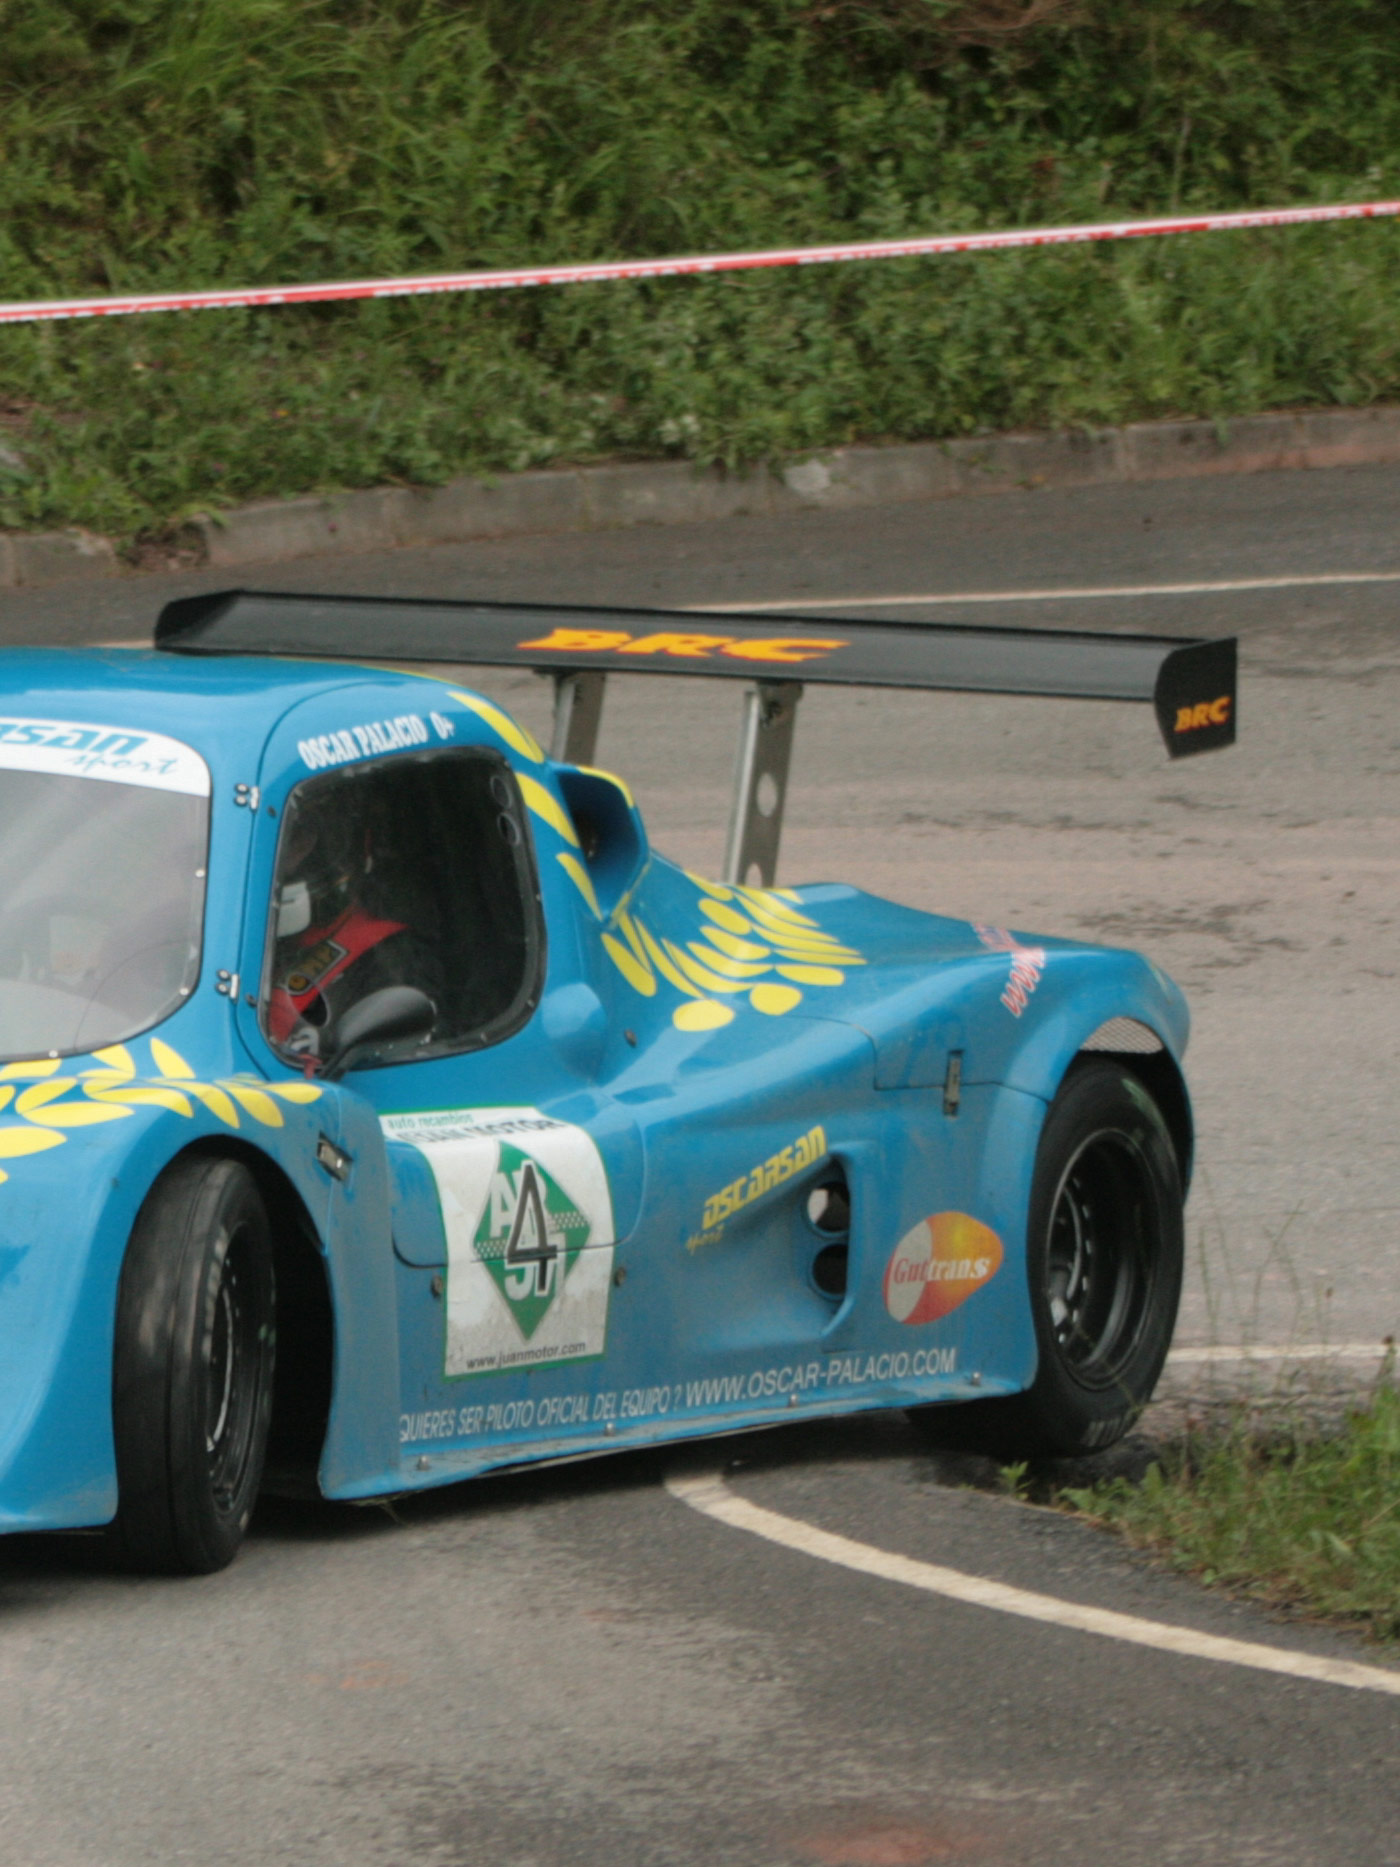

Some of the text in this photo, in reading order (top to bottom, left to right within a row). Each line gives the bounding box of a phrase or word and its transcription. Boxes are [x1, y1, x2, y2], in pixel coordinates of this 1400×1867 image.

[516, 627, 850, 663] BRC
[1173, 696, 1230, 733] BRC
[297, 729, 362, 770] OSCAR
[351, 714, 428, 757] PALACIO
[63, 751, 179, 776] sport
[507, 1160, 558, 1295] 4
[465, 1341, 586, 1369] www.juanmotor.com
[457, 1405, 485, 1436] SER
[485, 1400, 535, 1433] PILOTO
[536, 1394, 590, 1427] OFICIAL
[592, 1391, 617, 1421] DEL
[620, 1385, 671, 1418] EQUIPO
[672, 1383, 683, 1413] ?
[686, 1347, 956, 1408] WWW.OSCAR-PALACIO.COM
